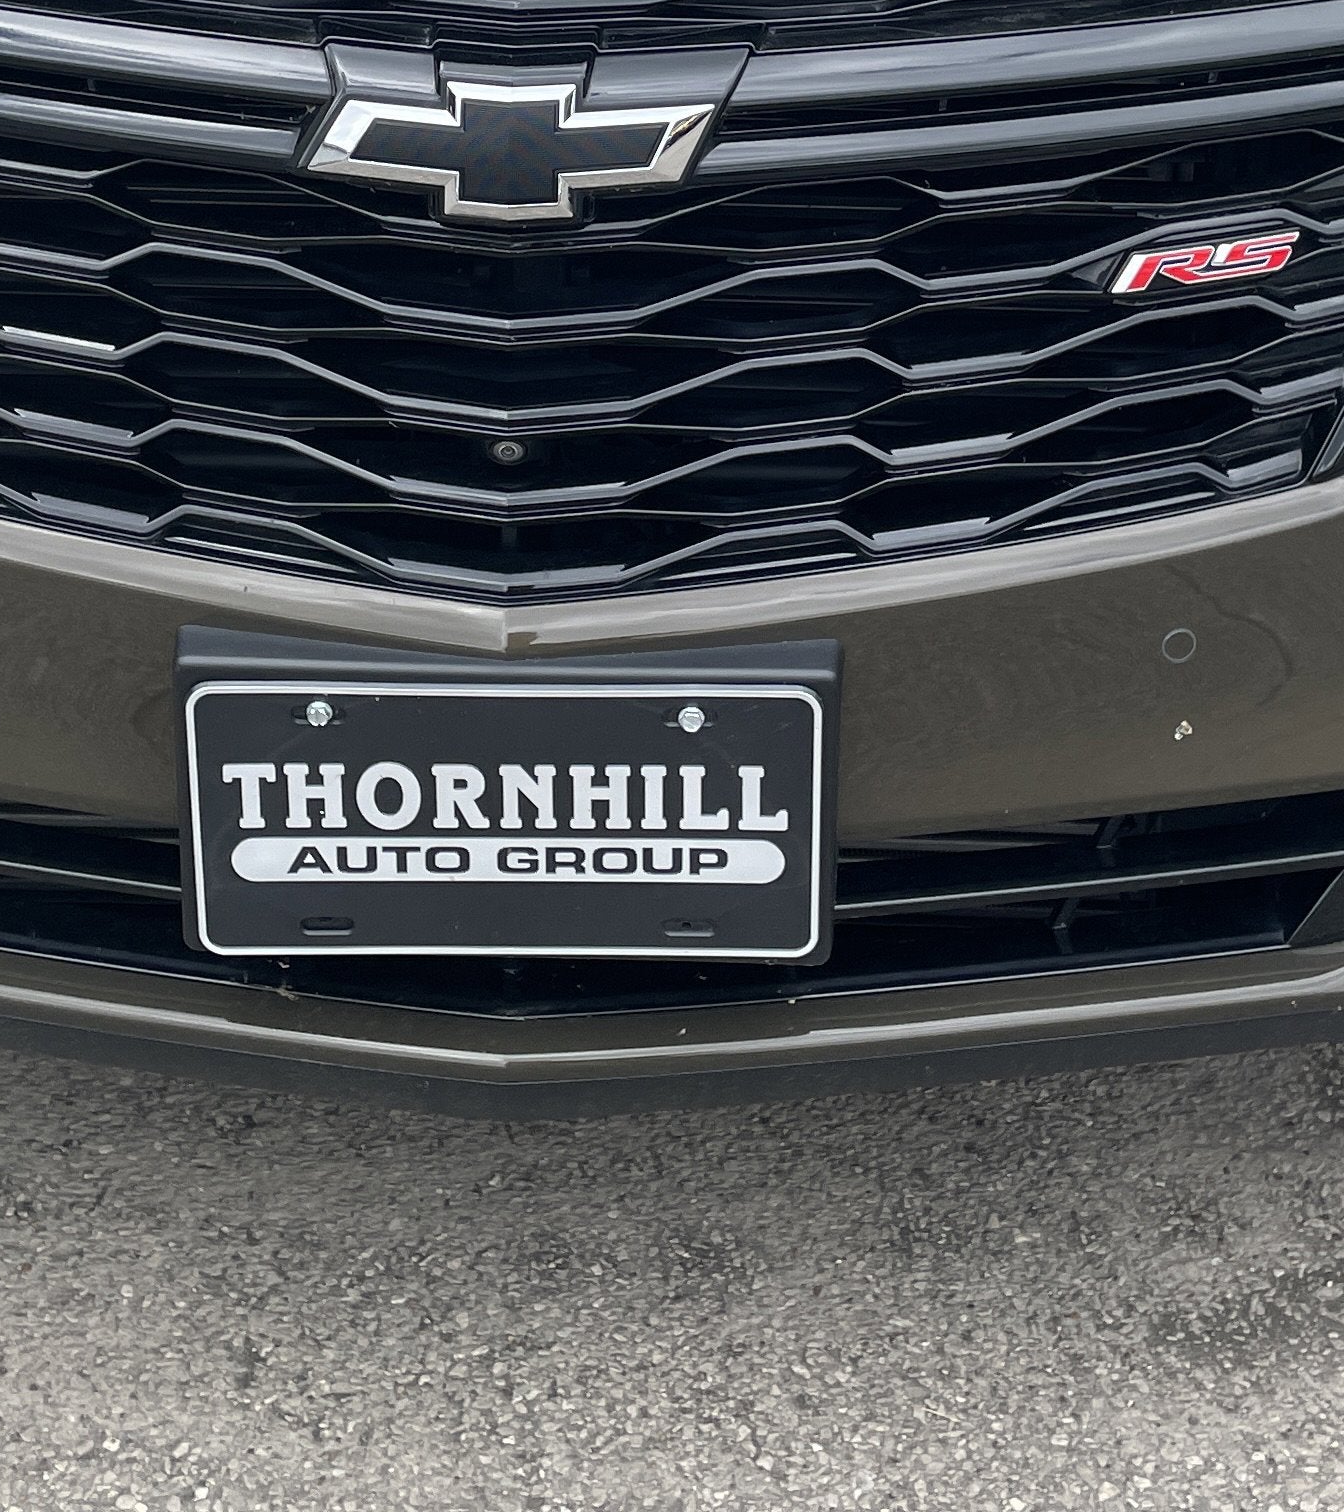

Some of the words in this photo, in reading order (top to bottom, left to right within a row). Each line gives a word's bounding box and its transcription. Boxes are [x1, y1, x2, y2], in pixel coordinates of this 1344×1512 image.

[1111, 231, 1300, 294] RS
[222, 760, 789, 832] THORNHILL
[286, 845, 472, 875] AUTO
[496, 845, 729, 876] GROUP
